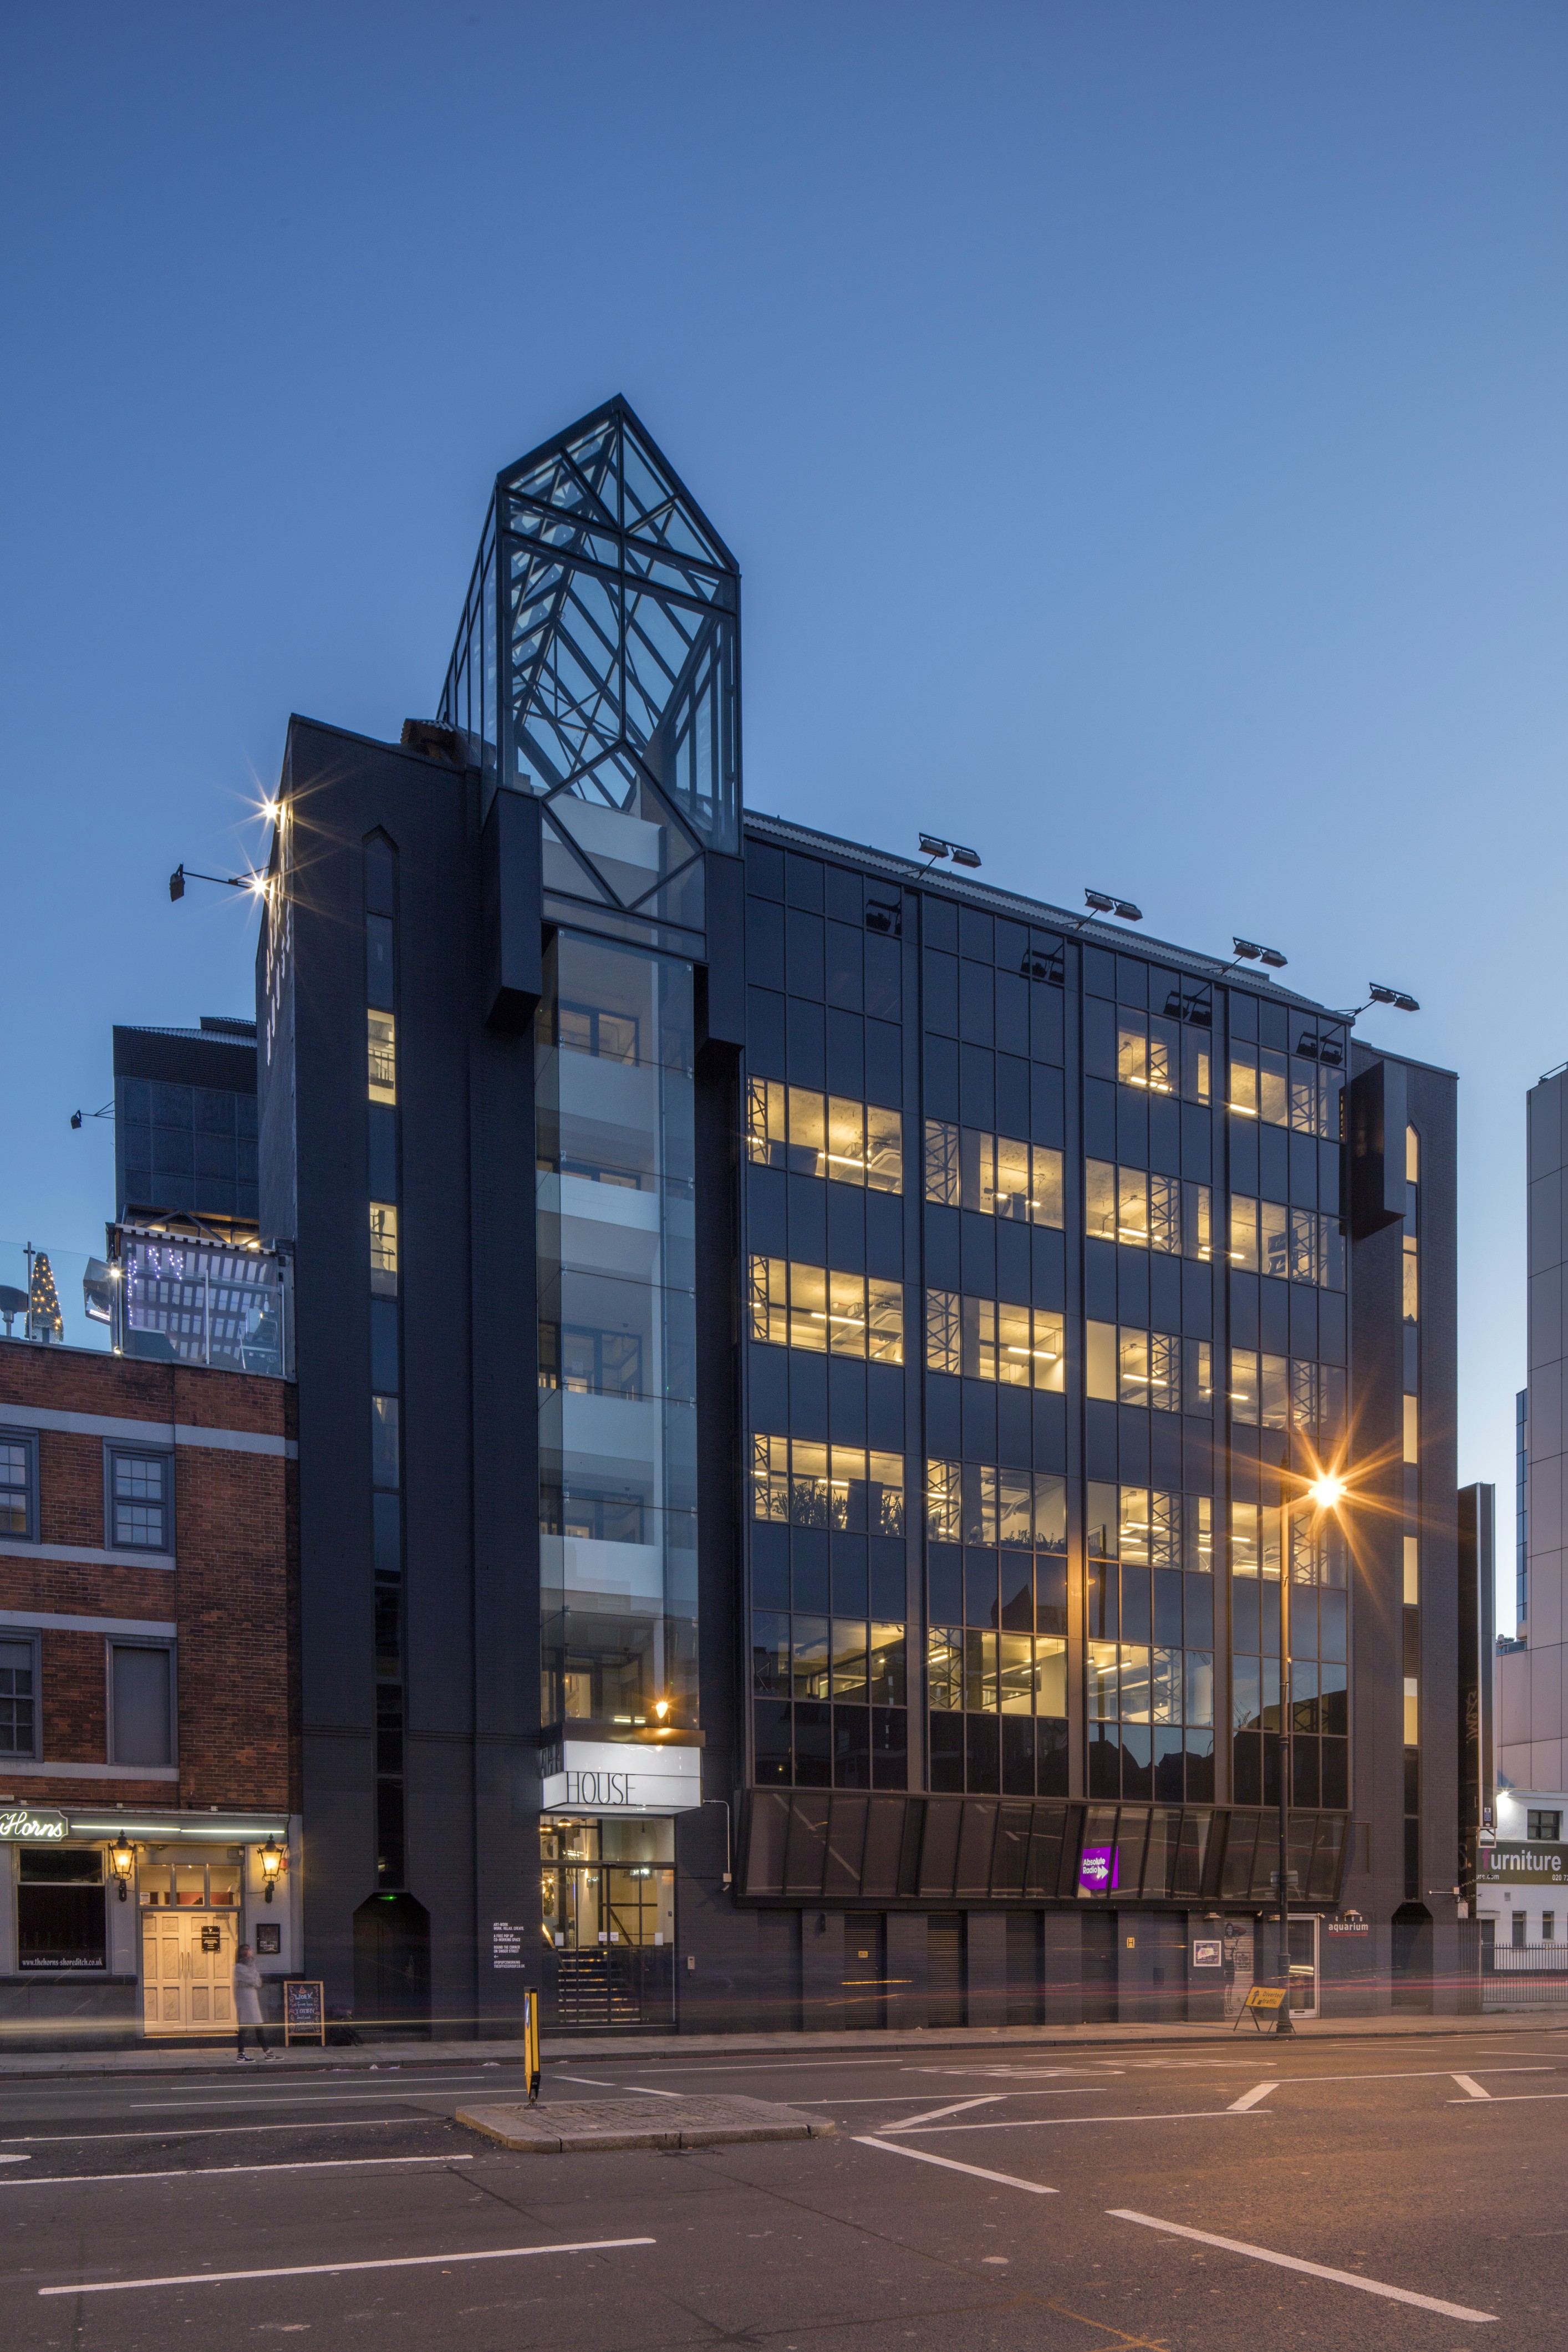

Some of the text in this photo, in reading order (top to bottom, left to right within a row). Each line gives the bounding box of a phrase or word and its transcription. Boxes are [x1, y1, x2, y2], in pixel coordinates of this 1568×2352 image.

[567, 1771, 636, 1805] HOUSE
[0, 1811, 62, 1837] Horns
[1083, 1857, 1106, 1866] Absolute
[1482, 1848, 1561, 1871] furniture
[1083, 1866, 1098, 1874] Radio
[1328, 1922, 1368, 1932] aquarium
[1128, 1938, 1134, 1947] H
